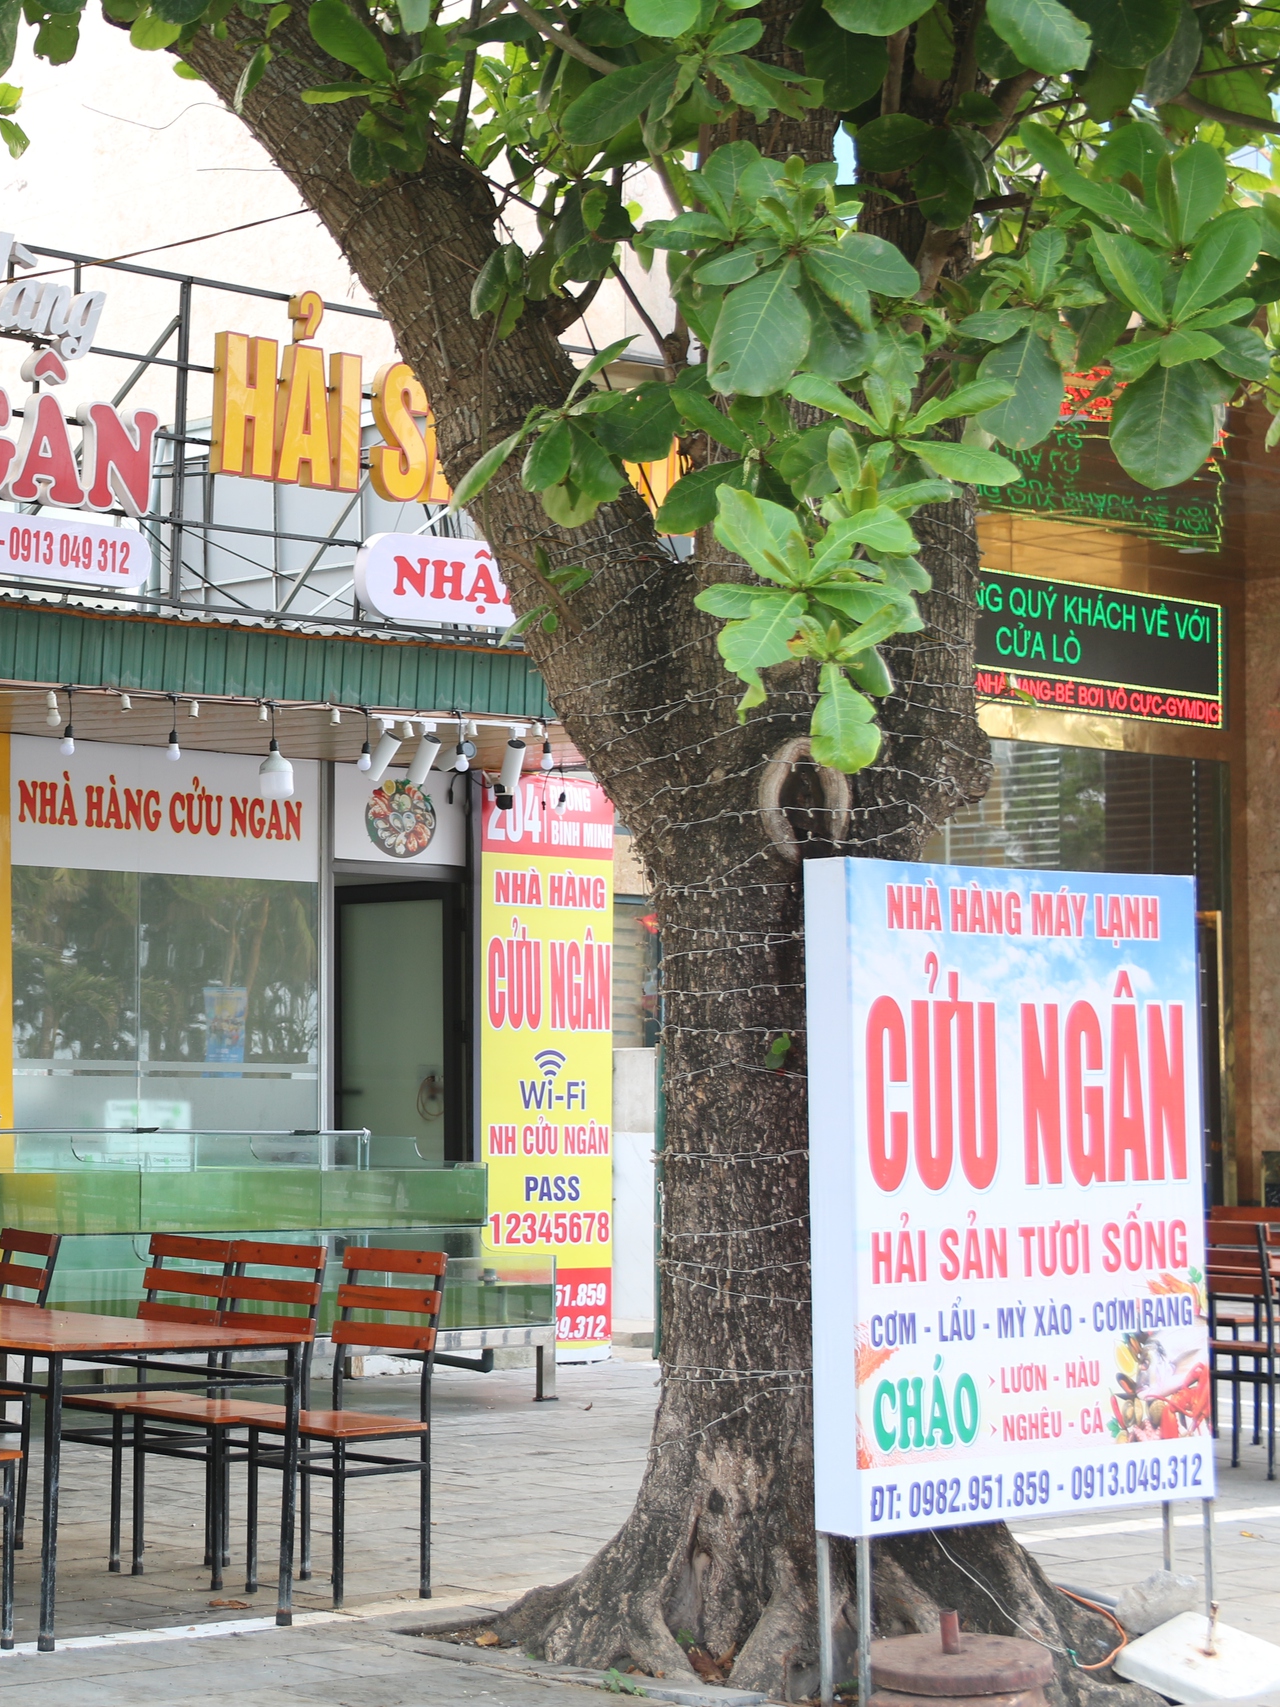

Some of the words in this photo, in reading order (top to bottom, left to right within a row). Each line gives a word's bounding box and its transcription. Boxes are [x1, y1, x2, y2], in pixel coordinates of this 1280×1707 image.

[210, 290, 363, 493] HẢI
[9, 526, 54, 565] 0913
[59, 533, 93, 570] 049
[97, 538, 130, 575] 312
[393, 549, 512, 615] NHẬ
[1009, 585, 1058, 620] QUÝ
[1064, 593, 1136, 632] KHÁCH
[1174, 608, 1211, 643] VỚI
[995, 621, 1047, 660] CỬA
[1052, 629, 1082, 664] LÒ
[1078, 687, 1105, 709] BƠI
[18, 770, 78, 826] NHÀ
[85, 774, 162, 832] HÀNG
[169, 776, 224, 836] CỬU
[487, 783, 541, 843] 204
[551, 815, 580, 847] BÌNH
[583, 823, 613, 849] MINH
[495, 868, 542, 905] NHÀ
[549, 870, 606, 909] HÀNG
[886, 879, 943, 932] NHÀ
[949, 881, 1021, 937] HÀNG
[1031, 886, 1086, 938] MÁY
[1094, 895, 1159, 947] LẠNH
[488, 916, 542, 1030] CỬU
[550, 928, 611, 1031] NGÂN
[519, 1079, 586, 1110] Wi-Fi
[865, 951, 999, 1193] CỬU
[1021, 970, 1189, 1188] NGÂN
[489, 1125, 516, 1155] NH
[523, 1116, 557, 1155] CỬU
[565, 1119, 609, 1155] NGÂN
[525, 1176, 580, 1202] PASS
[490, 1211, 610, 1245] 12345678
[870, 1212, 927, 1285] HẢI
[939, 1210, 1008, 1281] SẢN
[1018, 1218, 1091, 1278] TƯƠI
[1102, 1203, 1189, 1274] SỐNG
[870, 1310, 917, 1349] CƠM
[938, 1296, 976, 1342] LẨU
[997, 1300, 1026, 1339] MỲ
[1034, 1298, 1072, 1337] XÀO
[1092, 1298, 1136, 1333] CƠM
[1138, 1295, 1193, 1331] RANG
[1000, 1361, 1048, 1394] LƯƠN
[1065, 1355, 1101, 1388] HÀU
[873, 1353, 980, 1452] CHÁO
[1002, 1406, 1063, 1442] NGHÊU
[1081, 1400, 1104, 1435] CÁ
[870, 1484, 901, 1522] ĐT:
[909, 1469, 1050, 1518] 0982.951.859
[1071, 1452, 1203, 1500] 0913.049.312
